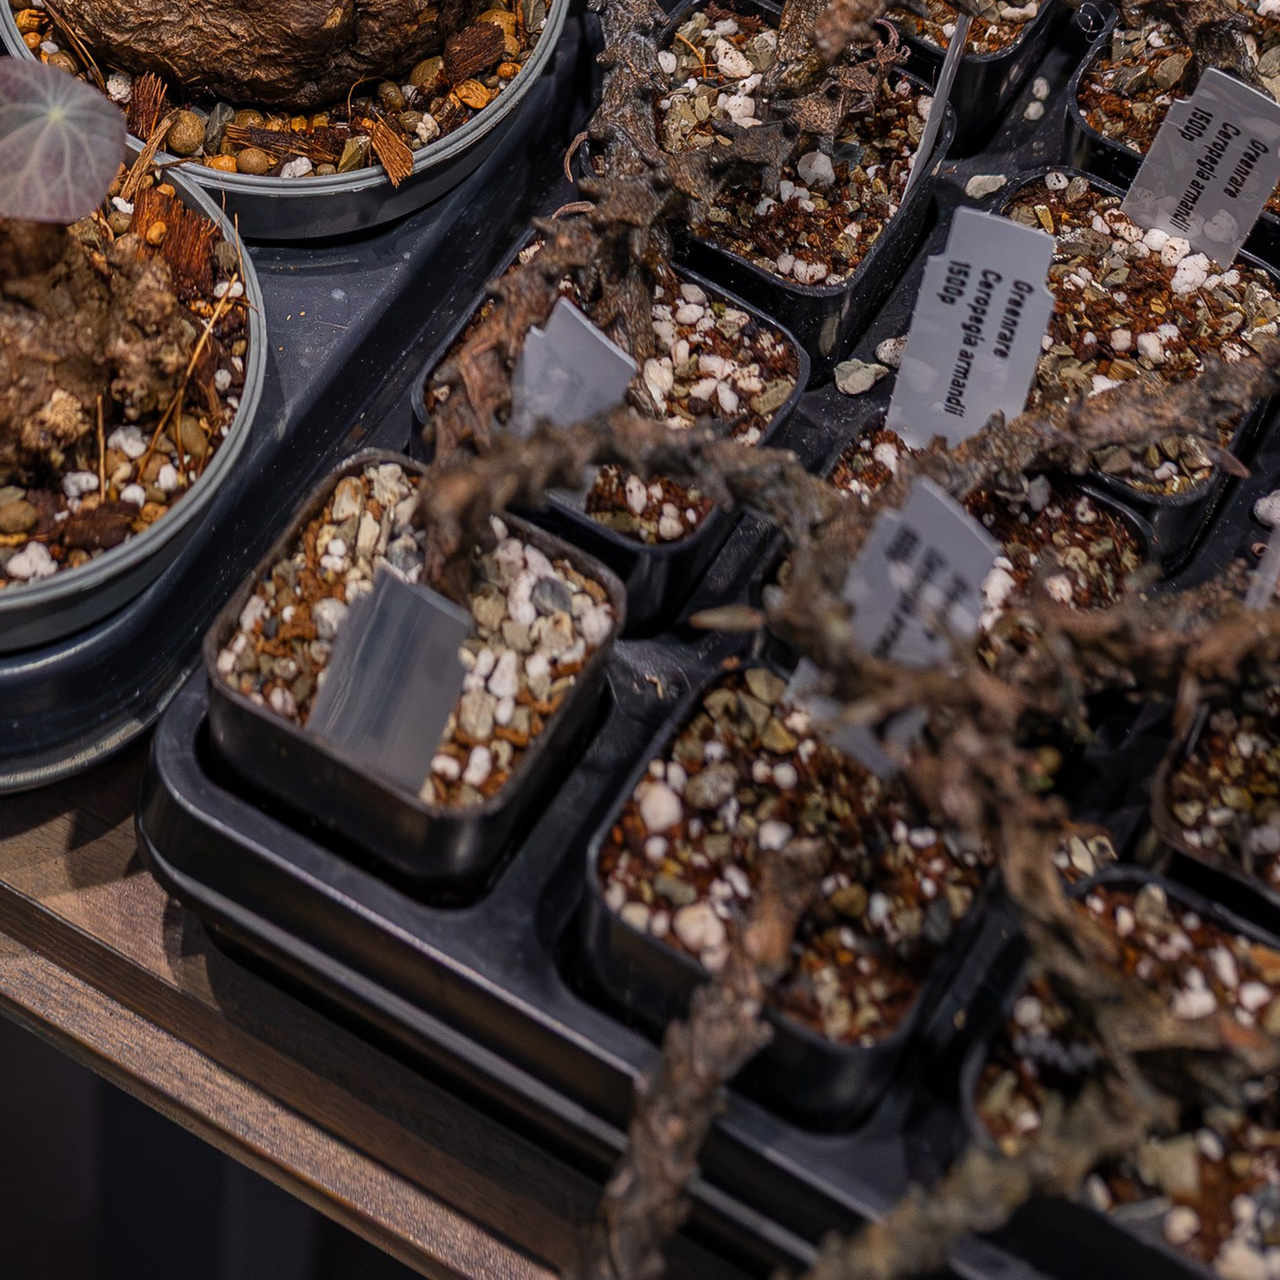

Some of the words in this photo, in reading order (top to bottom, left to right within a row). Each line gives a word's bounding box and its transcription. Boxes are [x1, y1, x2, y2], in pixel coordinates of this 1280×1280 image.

[1177, 107, 1214, 142] 1500p
[1195, 122, 1241, 183] Ceropegia
[1223, 139, 1269, 199] Greenrare
[1169, 178, 1206, 233] armandii
[937, 260, 971, 305] 1500p
[960, 269, 1002, 348] Ceropegia
[993, 280, 1034, 359] Greenrare
[944, 348, 975, 418] armandii
